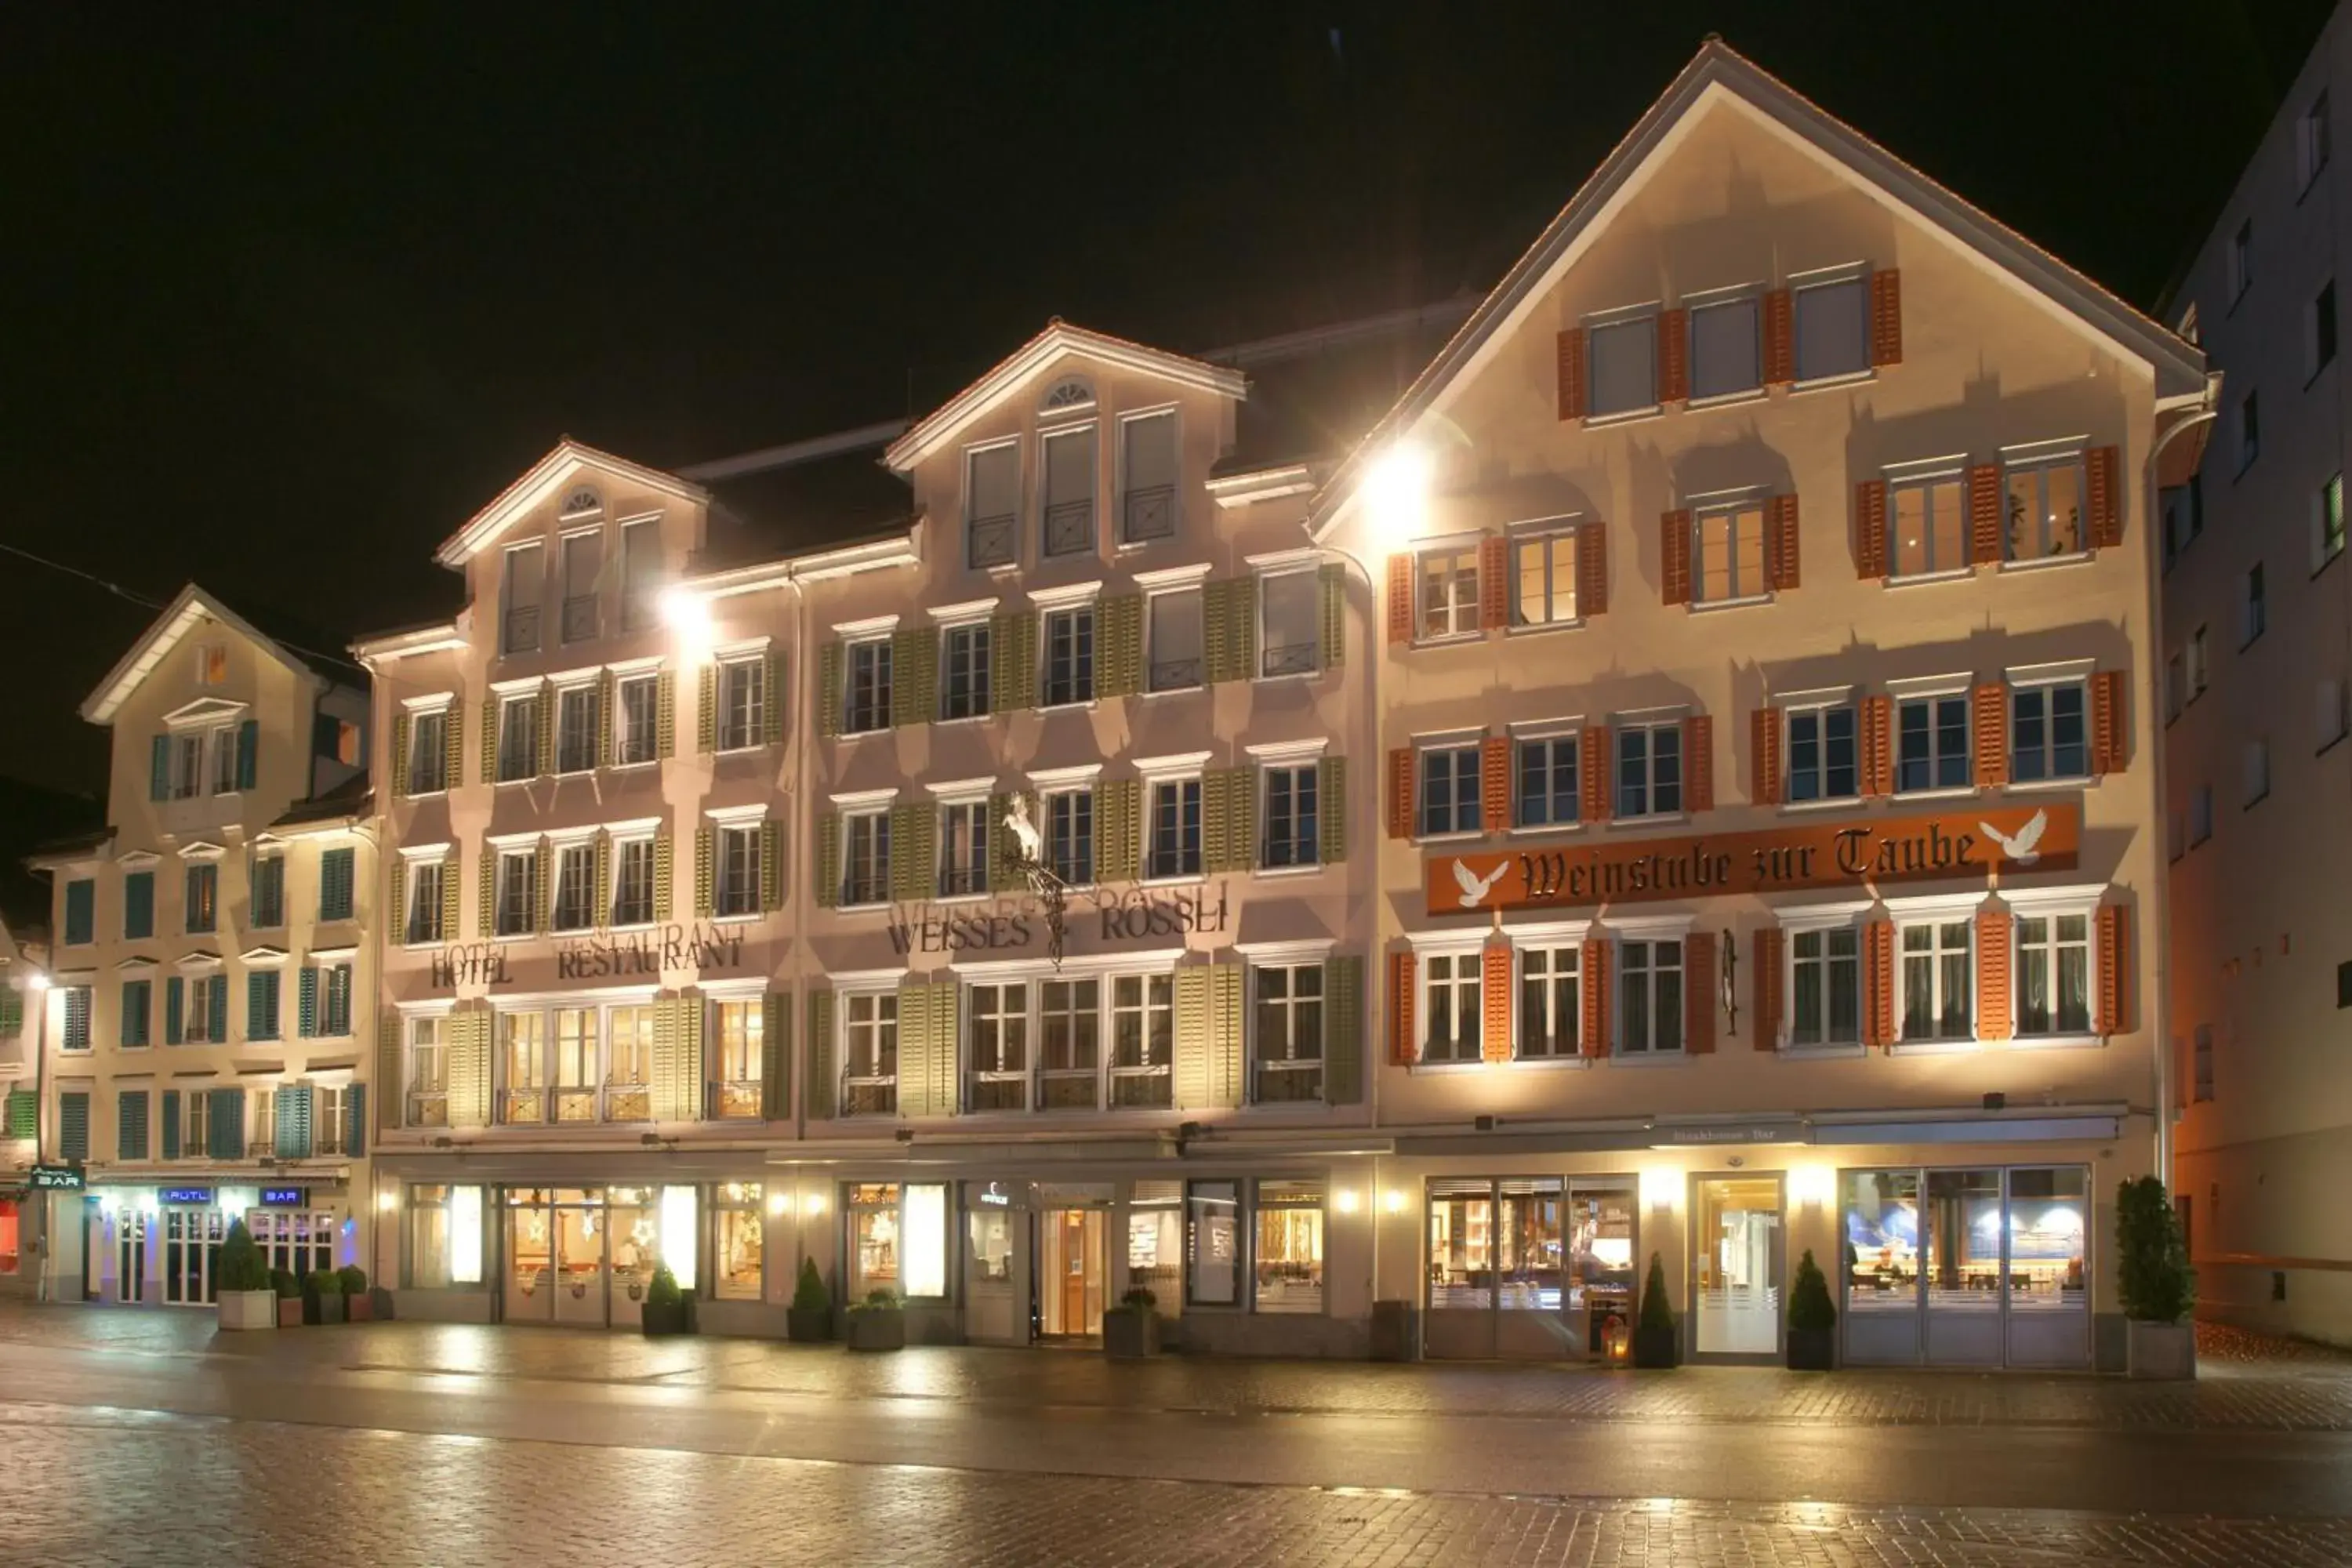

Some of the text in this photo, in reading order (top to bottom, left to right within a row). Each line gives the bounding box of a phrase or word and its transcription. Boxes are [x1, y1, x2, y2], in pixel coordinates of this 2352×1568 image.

[1519, 823, 1975, 900] Weinstube zur Taube
[887, 913, 1030, 955] WEISSES
[432, 938, 744, 989] HOTEL RESTAURANT
[38, 1177, 78, 1186] BAR
[266, 1191, 296, 1201] BAR
